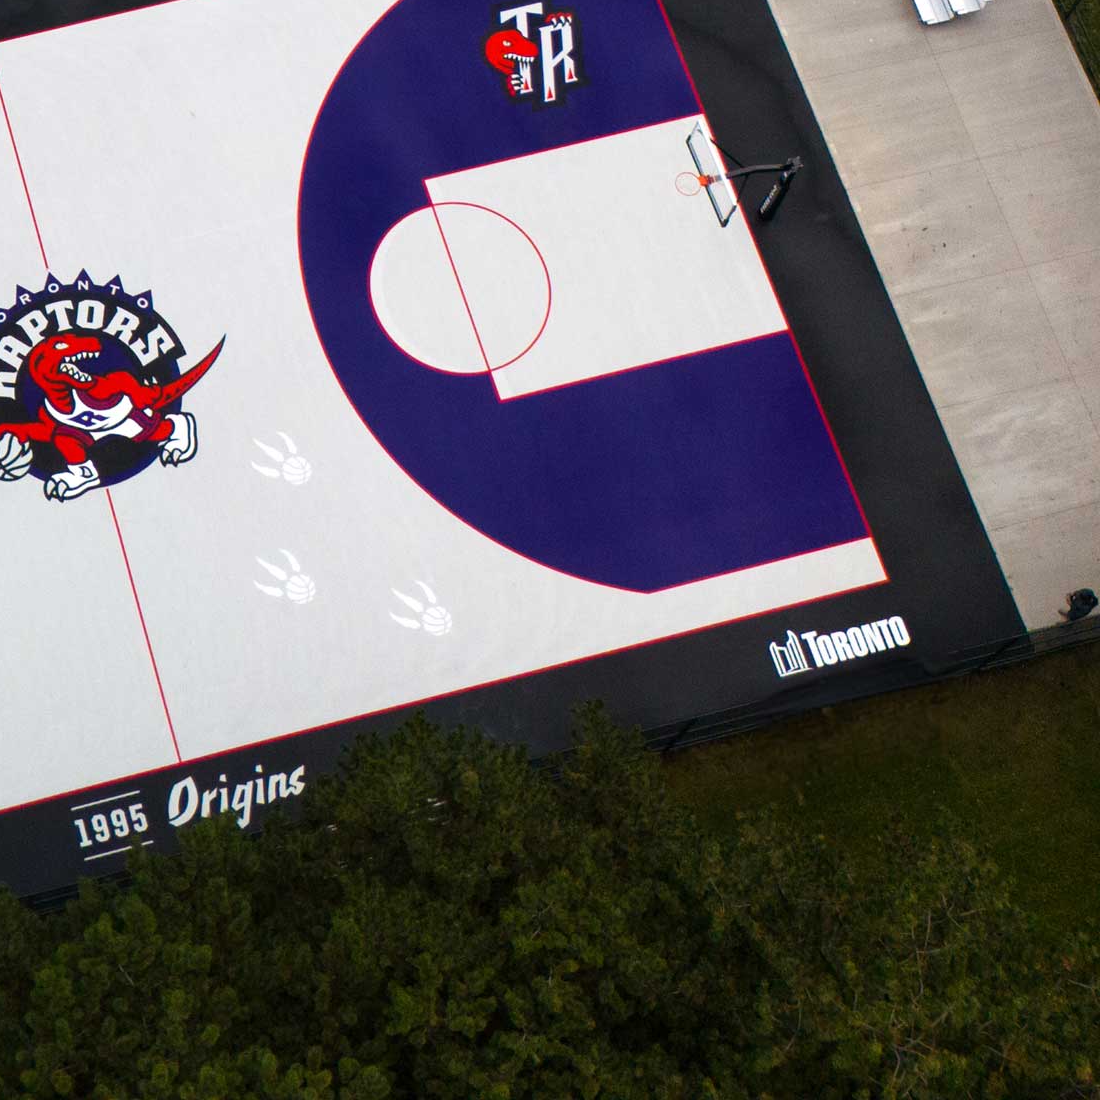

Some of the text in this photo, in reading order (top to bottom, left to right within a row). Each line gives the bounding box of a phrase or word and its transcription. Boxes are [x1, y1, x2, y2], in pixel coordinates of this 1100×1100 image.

[801, 615, 911, 668] TORONTO
[74, 764, 305, 848] 1995 Origins
